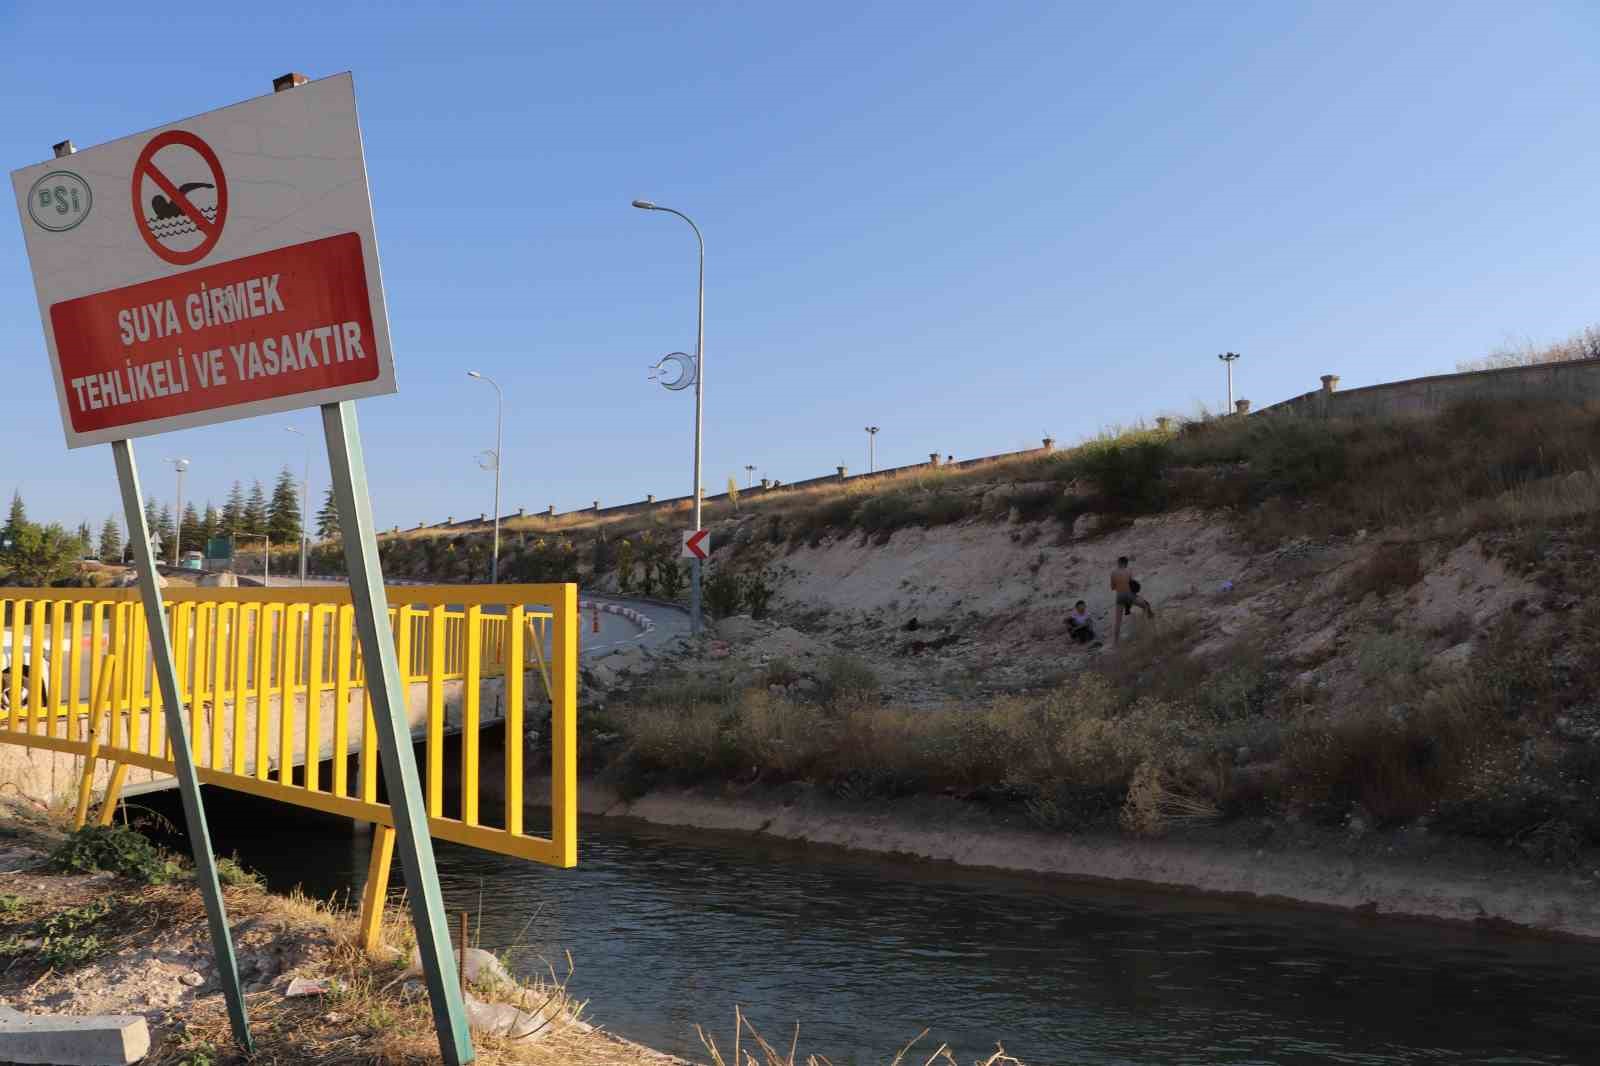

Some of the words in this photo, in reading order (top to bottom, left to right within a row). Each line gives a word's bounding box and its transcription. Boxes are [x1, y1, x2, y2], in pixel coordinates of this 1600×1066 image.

[117, 299, 182, 346] SUYA
[186, 274, 284, 330] GİRMEK
[72, 348, 190, 411] TEHLİKELİ
[191, 346, 226, 388] VE
[229, 322, 365, 380] YASAKTIR
